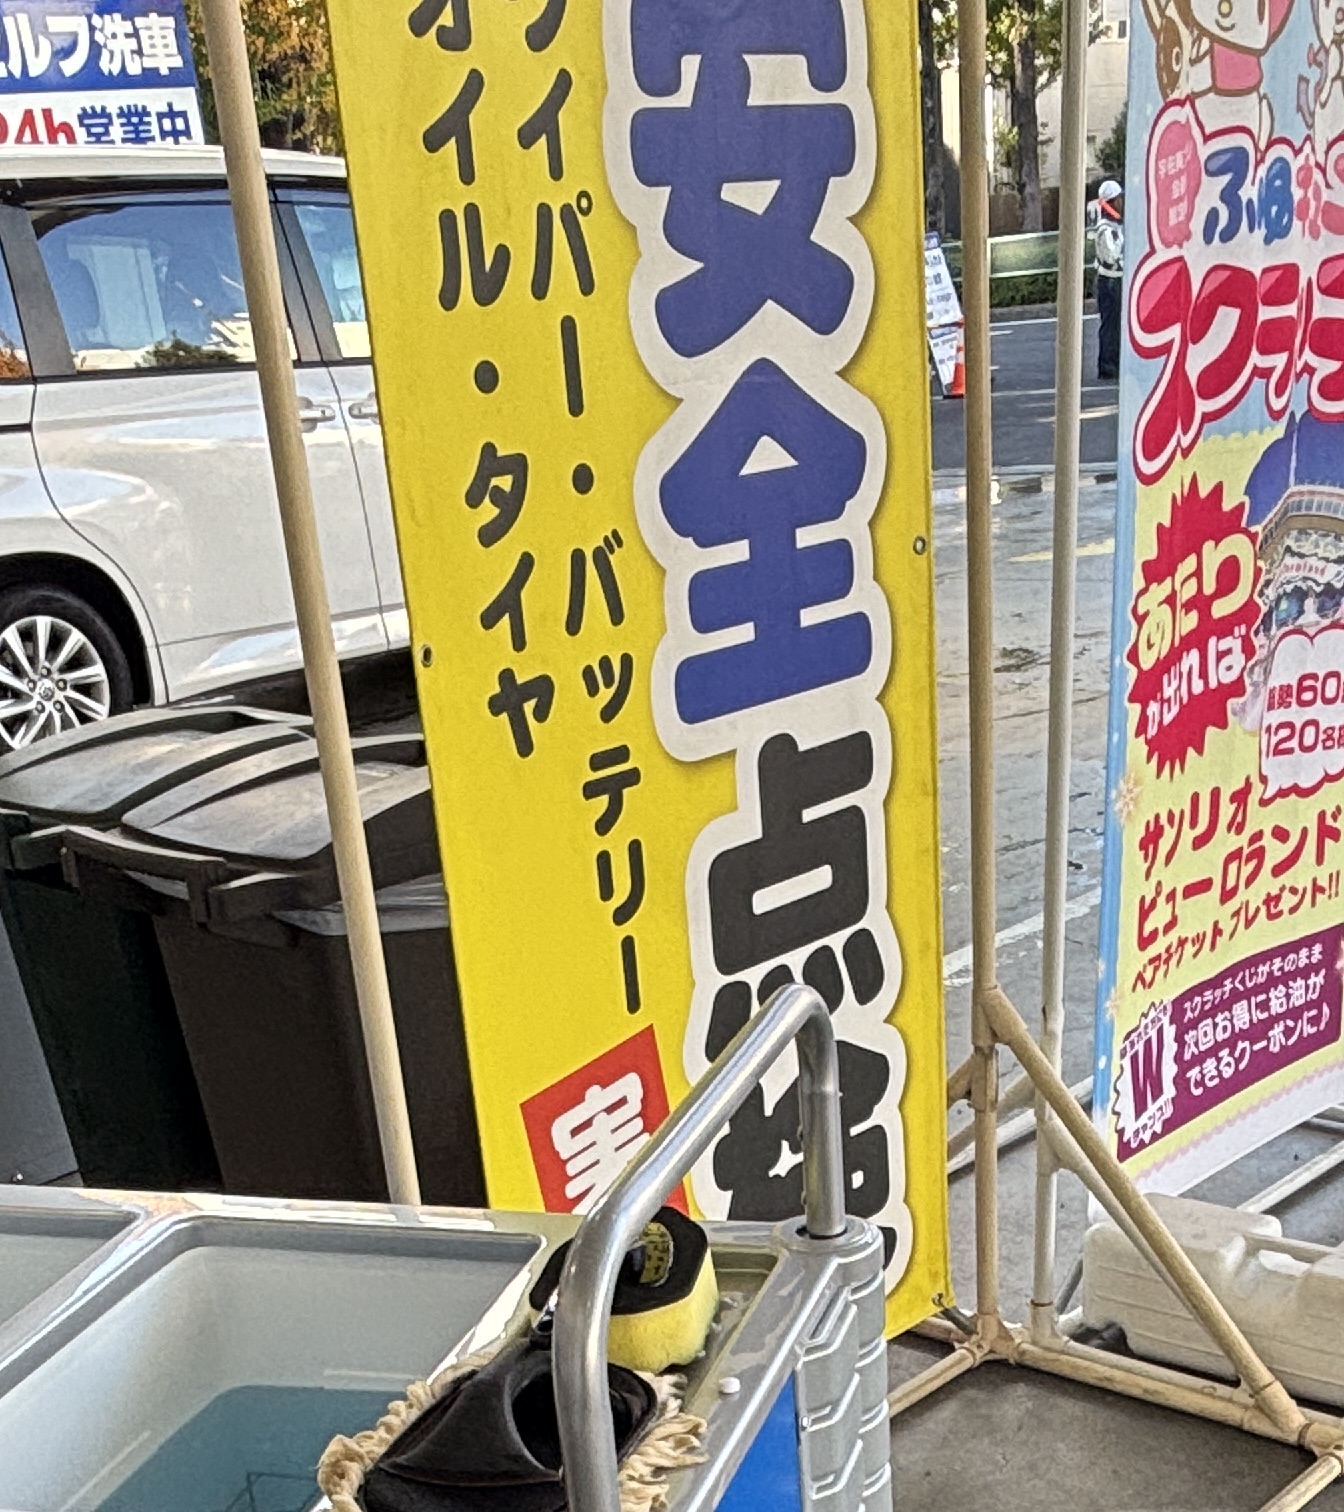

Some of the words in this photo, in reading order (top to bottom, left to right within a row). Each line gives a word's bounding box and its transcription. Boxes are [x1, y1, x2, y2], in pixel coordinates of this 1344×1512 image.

[1137, 533, 1255, 671] あたり
[1146, 624, 1246, 740] が出れば
[1136, 805, 1343, 951] ピューロランド
[1138, 774, 1254, 881] サンリオ
[1183, 942, 1324, 1023] スクラッチくじがそのまま
[1183, 968, 1326, 1061] 次回お得に給油が
[1130, 1022, 1165, 1123] W
